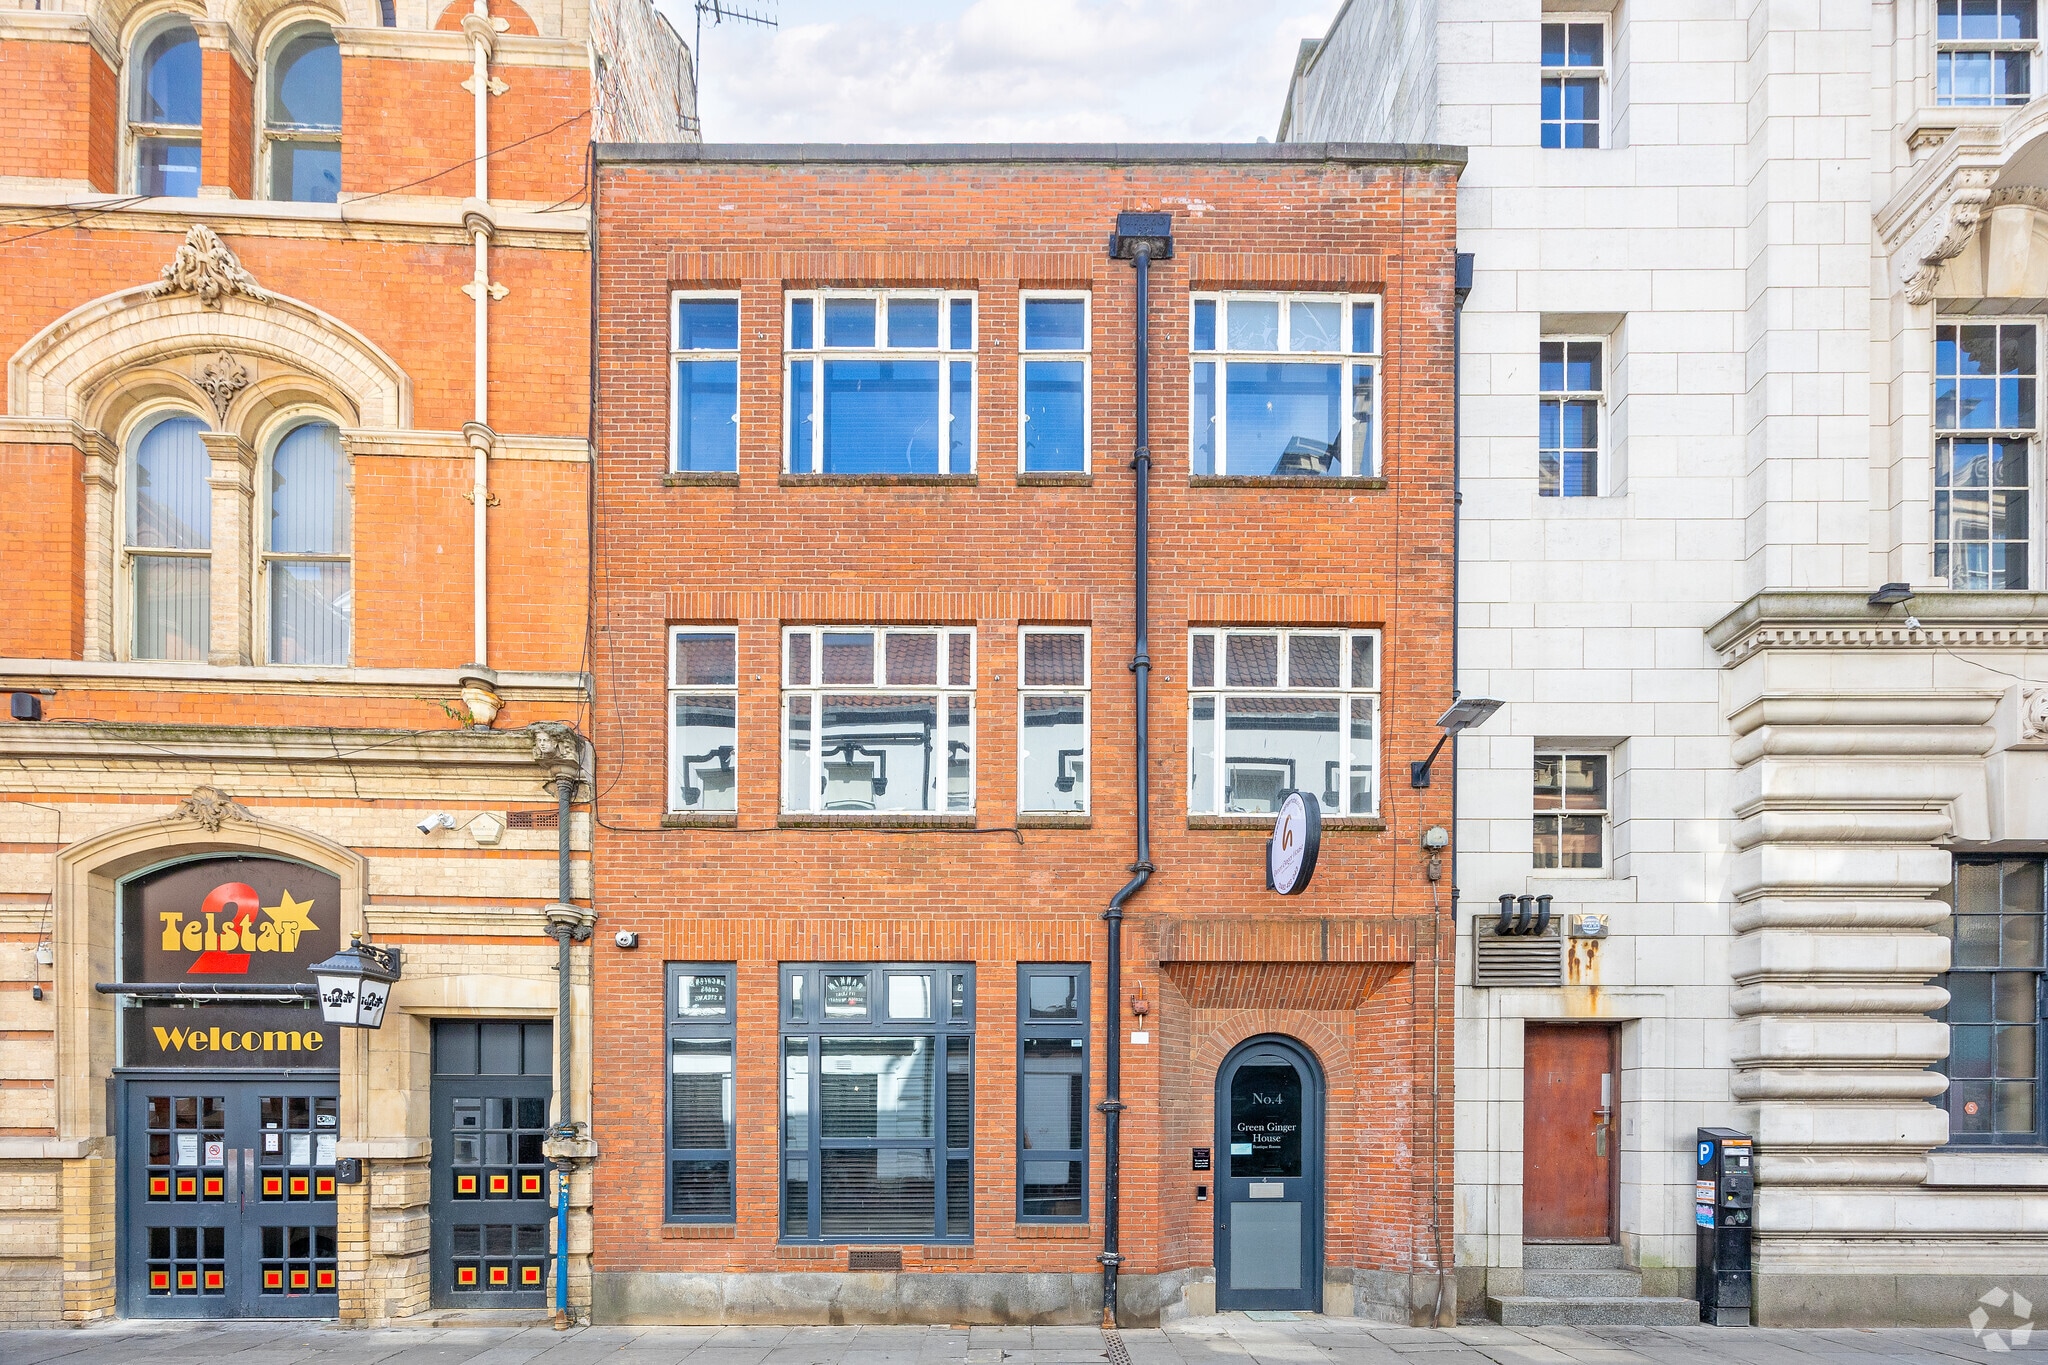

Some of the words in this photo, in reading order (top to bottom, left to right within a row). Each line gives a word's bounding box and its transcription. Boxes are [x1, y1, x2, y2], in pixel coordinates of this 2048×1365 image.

[159, 911, 299, 952] Telstar
[322, 993, 352, 1004] Telstar
[152, 1026, 324, 1052] Welcome
[1252, 1092, 1283, 1105] No.4
[1237, 1122, 1265, 1132] Green
[1266, 1122, 1297, 1133] Ginger
[1252, 1133, 1282, 1143] House
[1700, 1143, 1710, 1161] P
